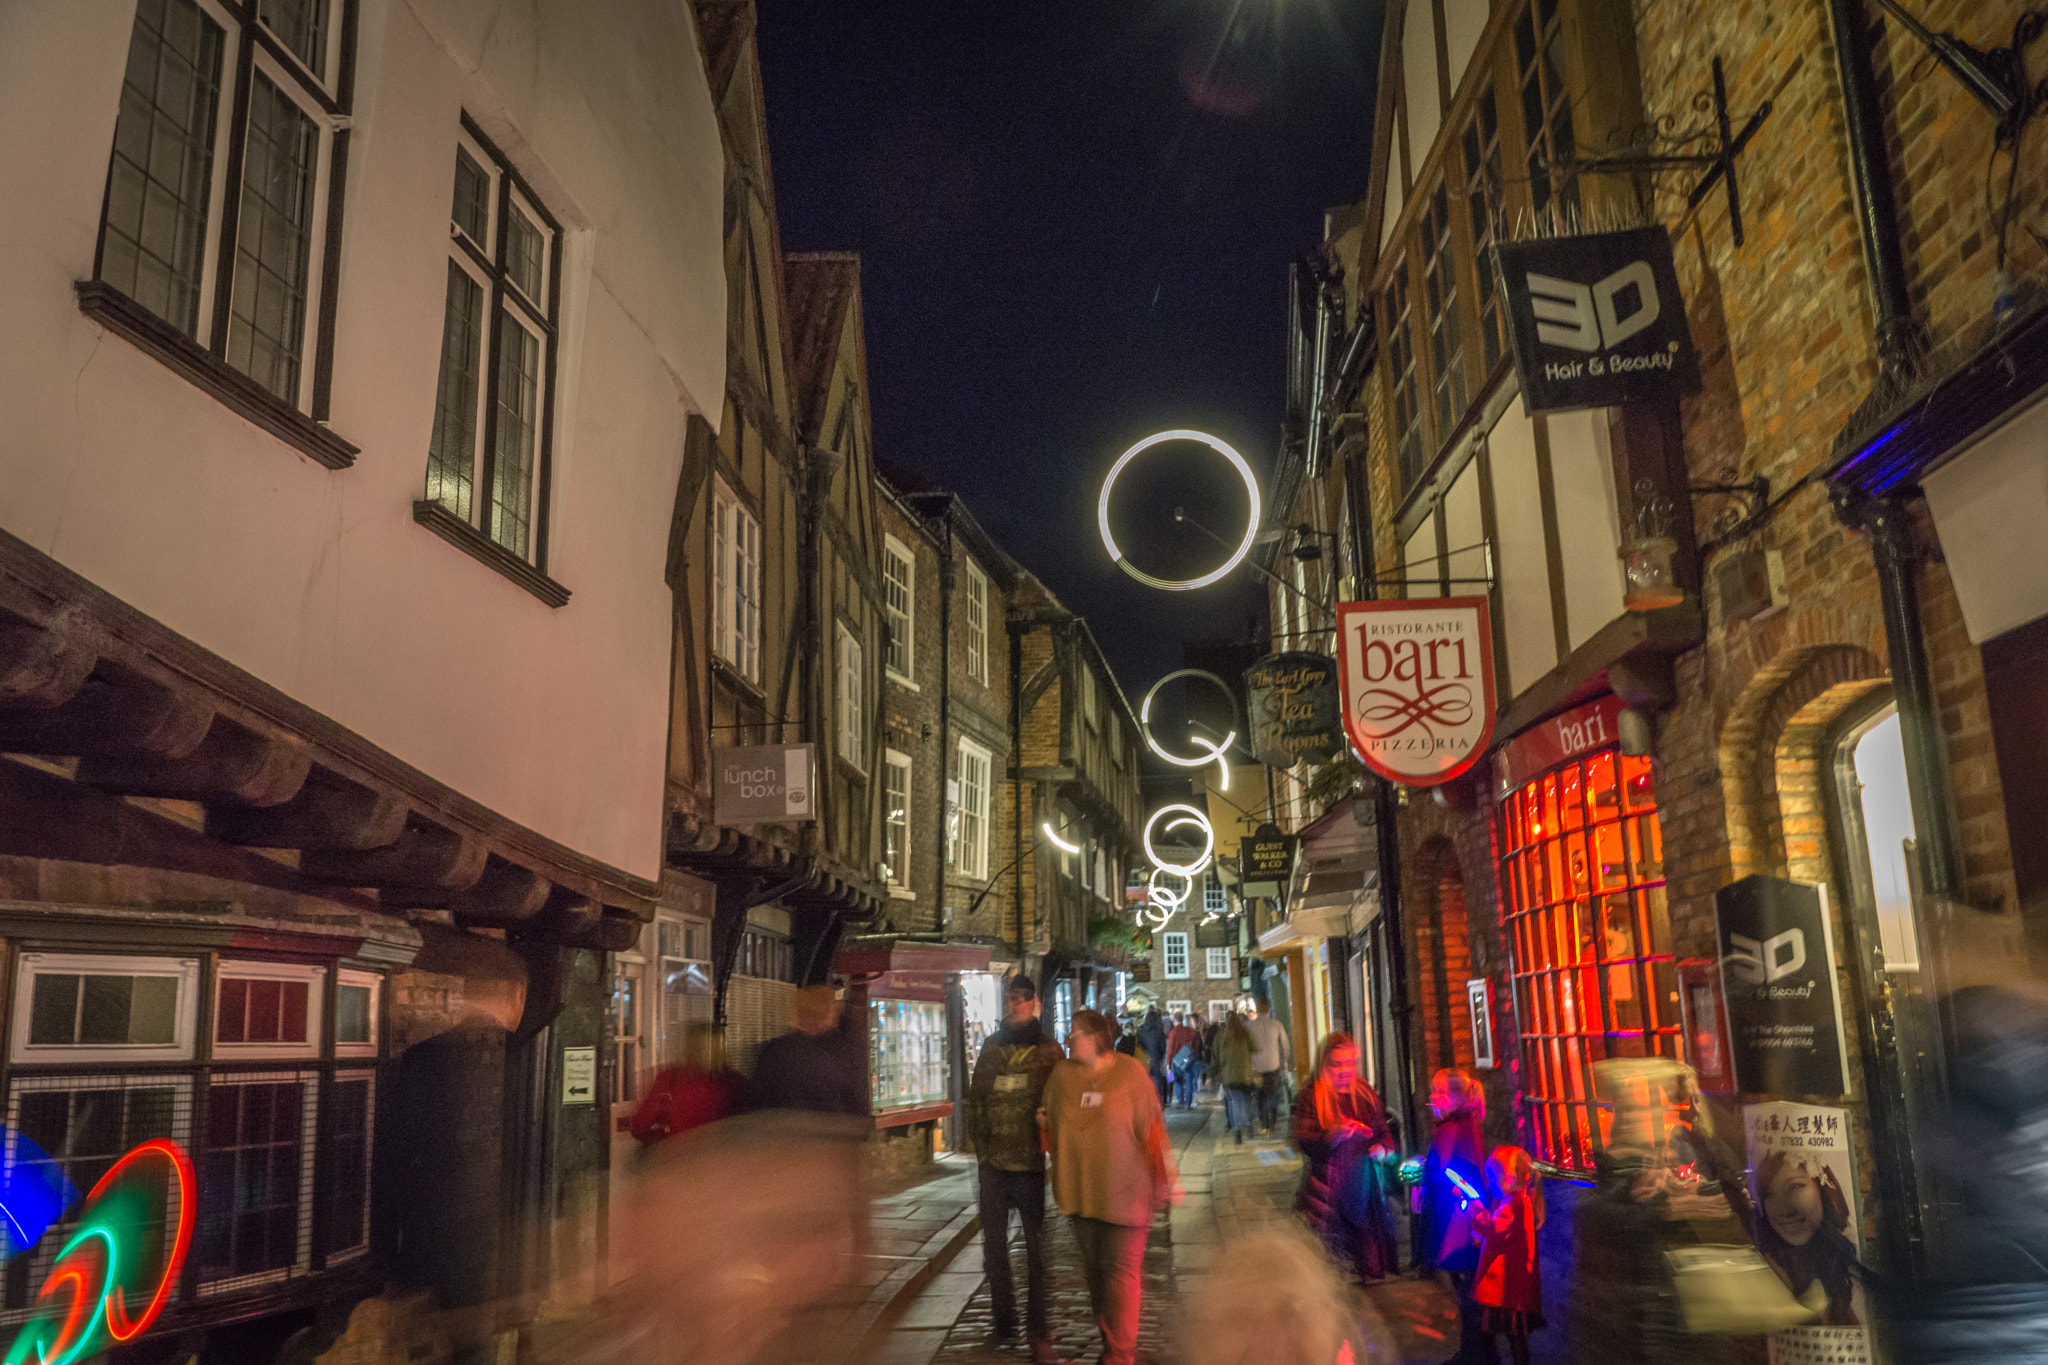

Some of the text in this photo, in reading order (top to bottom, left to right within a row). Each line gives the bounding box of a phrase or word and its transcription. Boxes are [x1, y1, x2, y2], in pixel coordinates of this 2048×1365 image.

[1526, 259, 1660, 353] 3D
[1545, 343, 1677, 382] Hair & Beauty
[1371, 621, 1465, 636] RISTORANTE
[1354, 622, 1474, 683] bari
[1254, 670, 1273, 688] The
[1263, 684, 1314, 722] Tea
[1261, 721, 1330, 753] Rooms
[1556, 704, 1608, 756] bari
[1371, 738, 1470, 752] PIZZERIA
[724, 766, 776, 784] lunch
[741, 782, 776, 799] box
[1252, 851, 1288, 861] WALKER
[1268, 860, 1283, 869] CO
[1768, 980, 1816, 1001] Beauty
[1808, 1137, 1835, 1147] 430982
